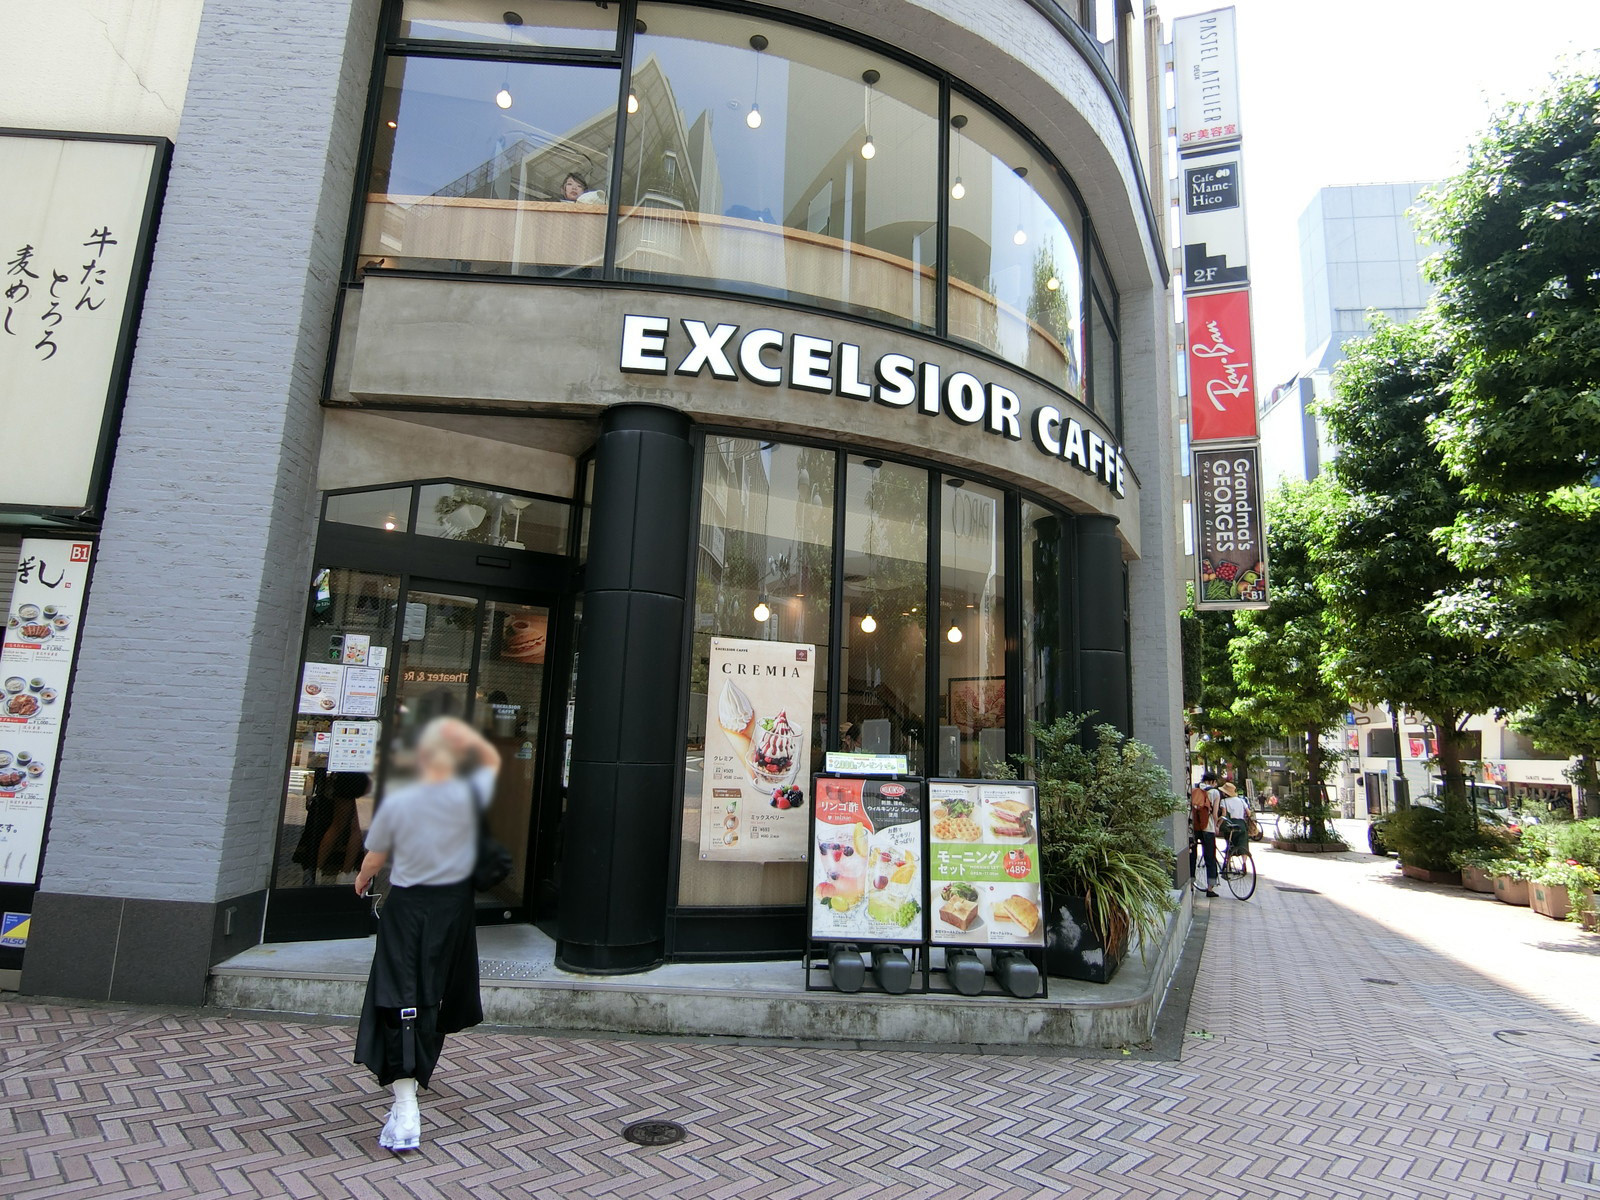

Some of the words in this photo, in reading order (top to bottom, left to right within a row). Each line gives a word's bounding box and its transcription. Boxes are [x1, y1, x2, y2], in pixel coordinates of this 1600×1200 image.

[1200, 17, 1218, 62] PASTEL
[1202, 70, 1221, 123] ATELIER
[1183, 124, 1236, 142] 3F美容室
[1192, 173, 1214, 184] Cafe
[1192, 195, 1222, 207] Hico
[75, 226, 118, 311] 牛たん
[1193, 267, 1218, 283] 2F
[5, 244, 39, 335] 麦めし
[35, 268, 69, 361] とろろ
[620, 314, 1022, 442] EXCELSIOR
[1212, 459, 1235, 552] GEORGES
[1233, 458, 1254, 551] Grandma's
[71, 546, 89, 560] B1
[1251, 590, 1263, 600] B1
[721, 662, 801, 678] CREMIA
[821, 801, 859, 813] リンゴ酢
[937, 850, 1001, 865] モーニング
[938, 863, 966, 876] セット
[1, 937, 28, 945] ALSO
